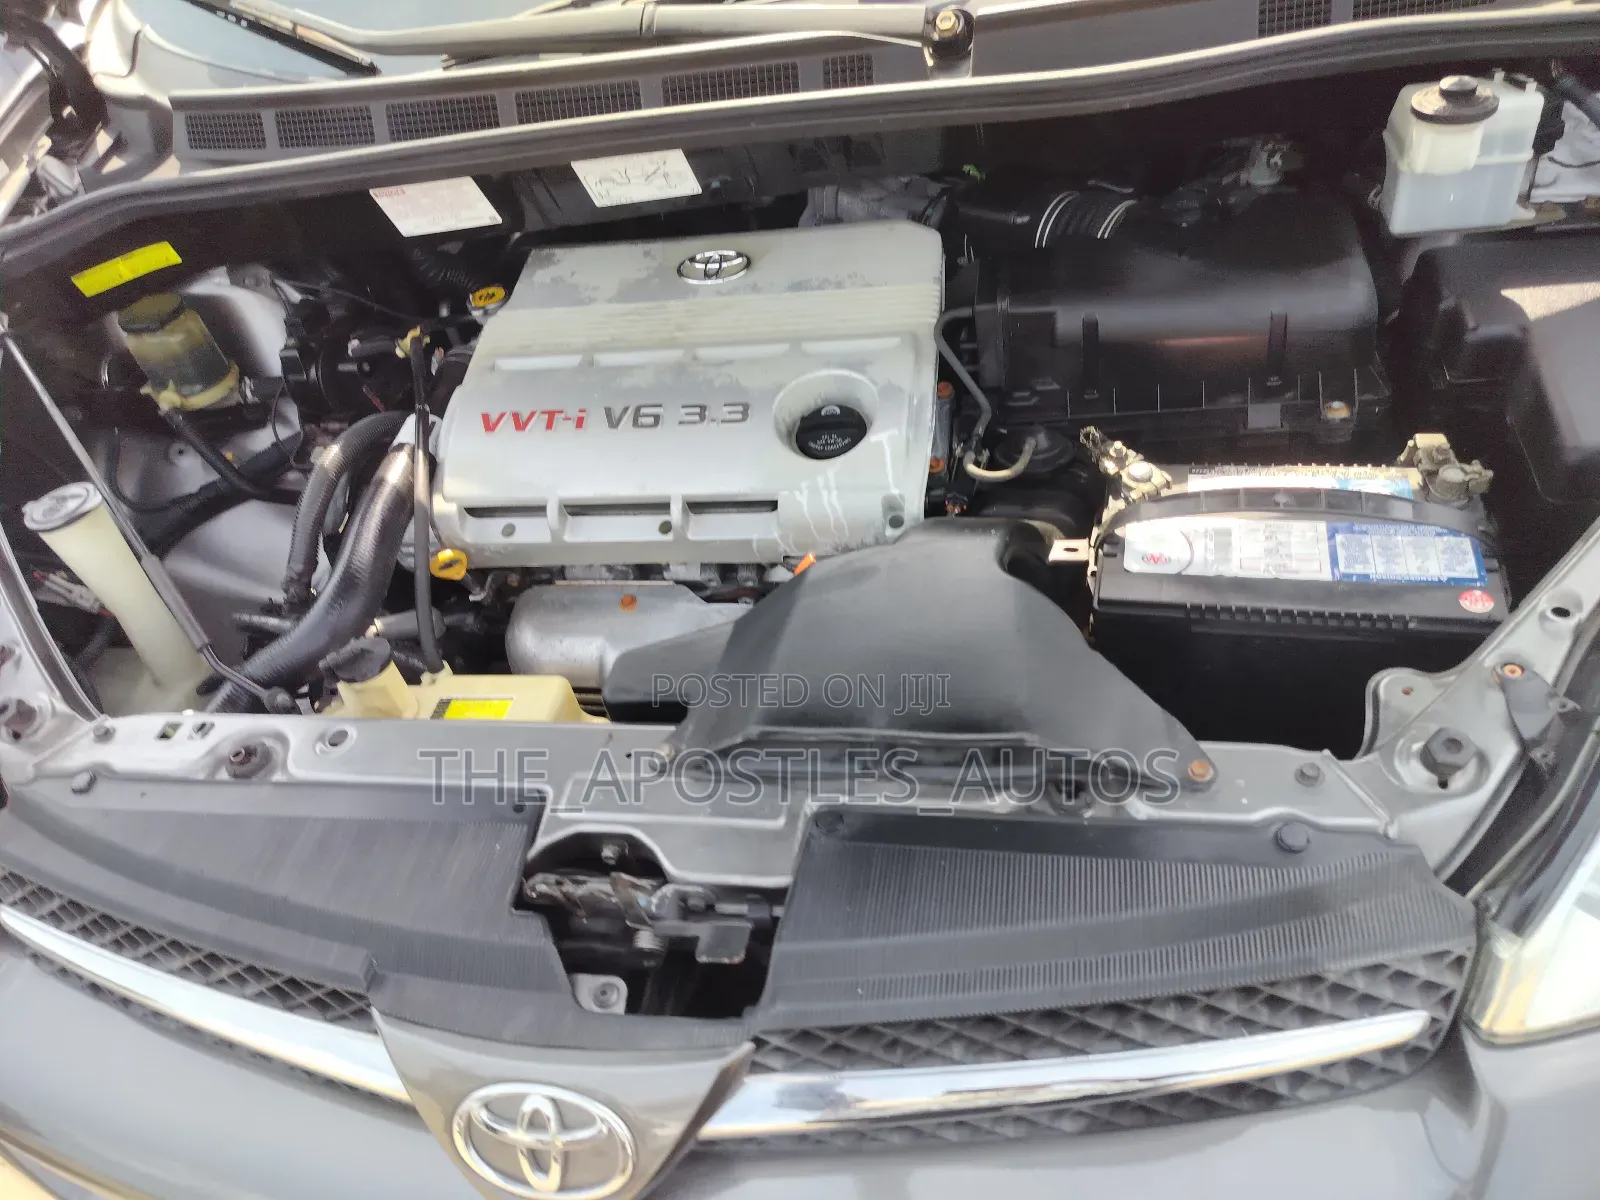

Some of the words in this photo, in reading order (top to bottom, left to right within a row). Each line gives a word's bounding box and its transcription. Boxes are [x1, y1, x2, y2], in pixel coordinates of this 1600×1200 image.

[480, 407, 588, 434] VVT-i
[603, 403, 662, 430] V6
[678, 403, 750, 425] 3.3
